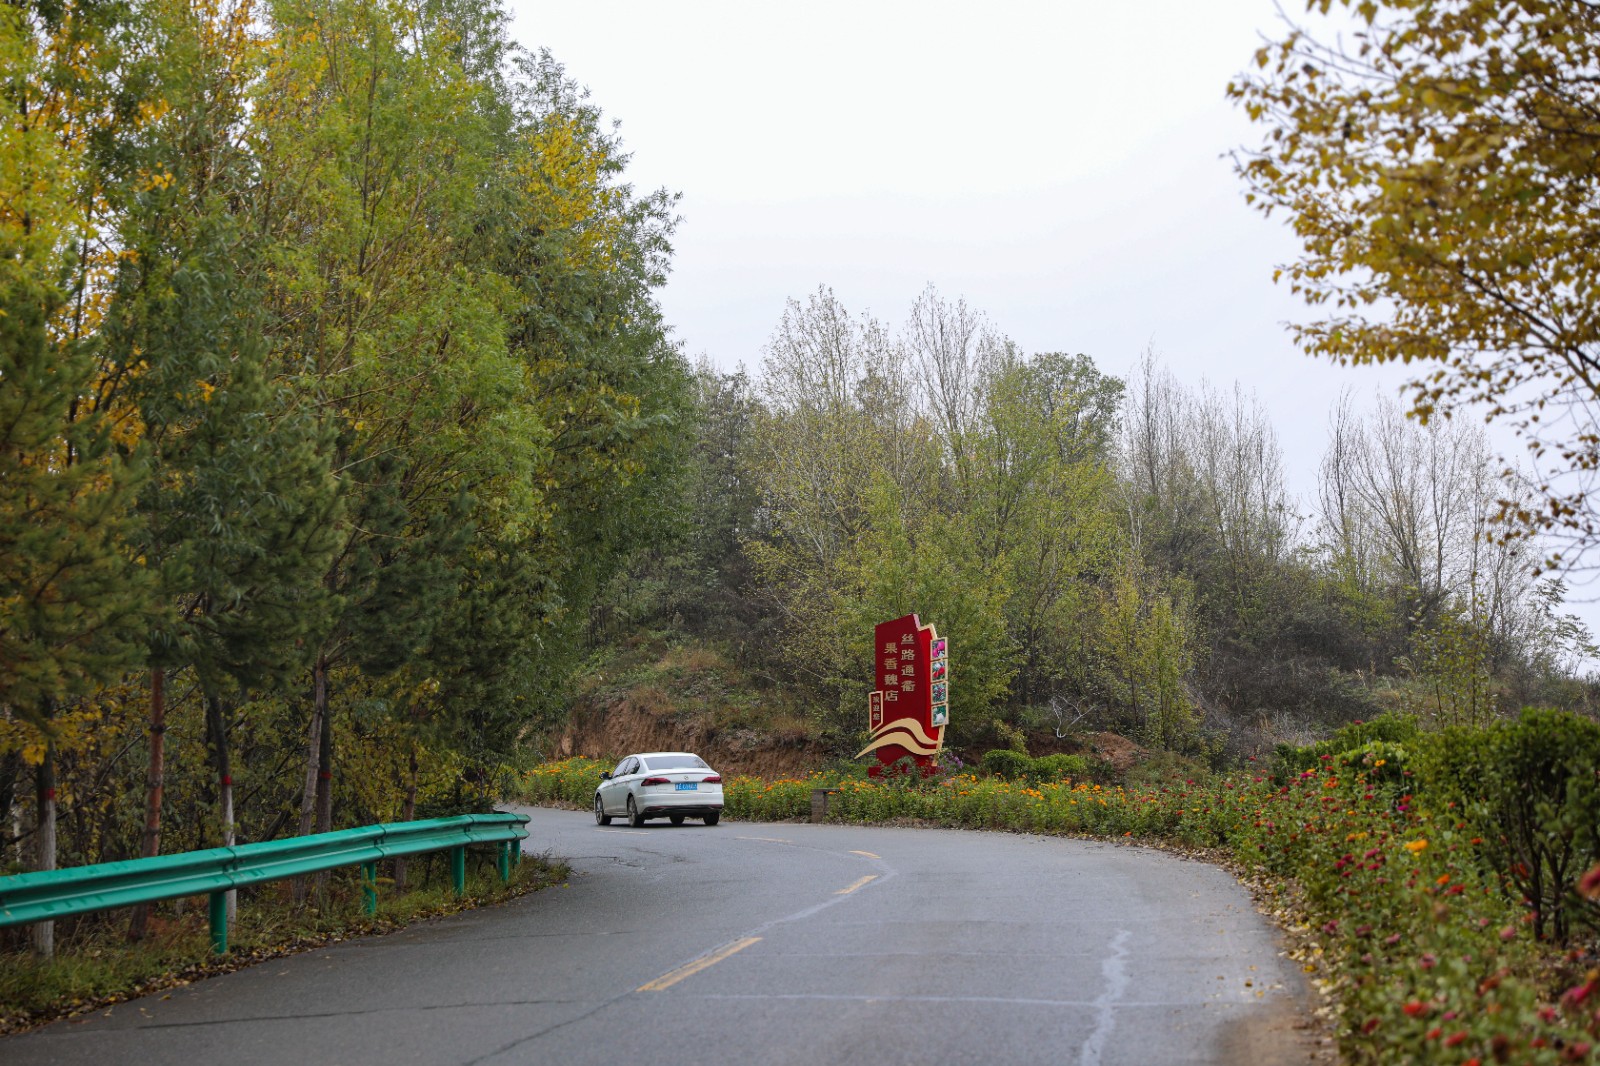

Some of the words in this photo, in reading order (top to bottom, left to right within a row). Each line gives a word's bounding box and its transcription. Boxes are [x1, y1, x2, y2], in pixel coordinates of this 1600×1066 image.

[884, 642, 898, 702] 果香魏店
[901, 633, 915, 692] 丝路通衢
